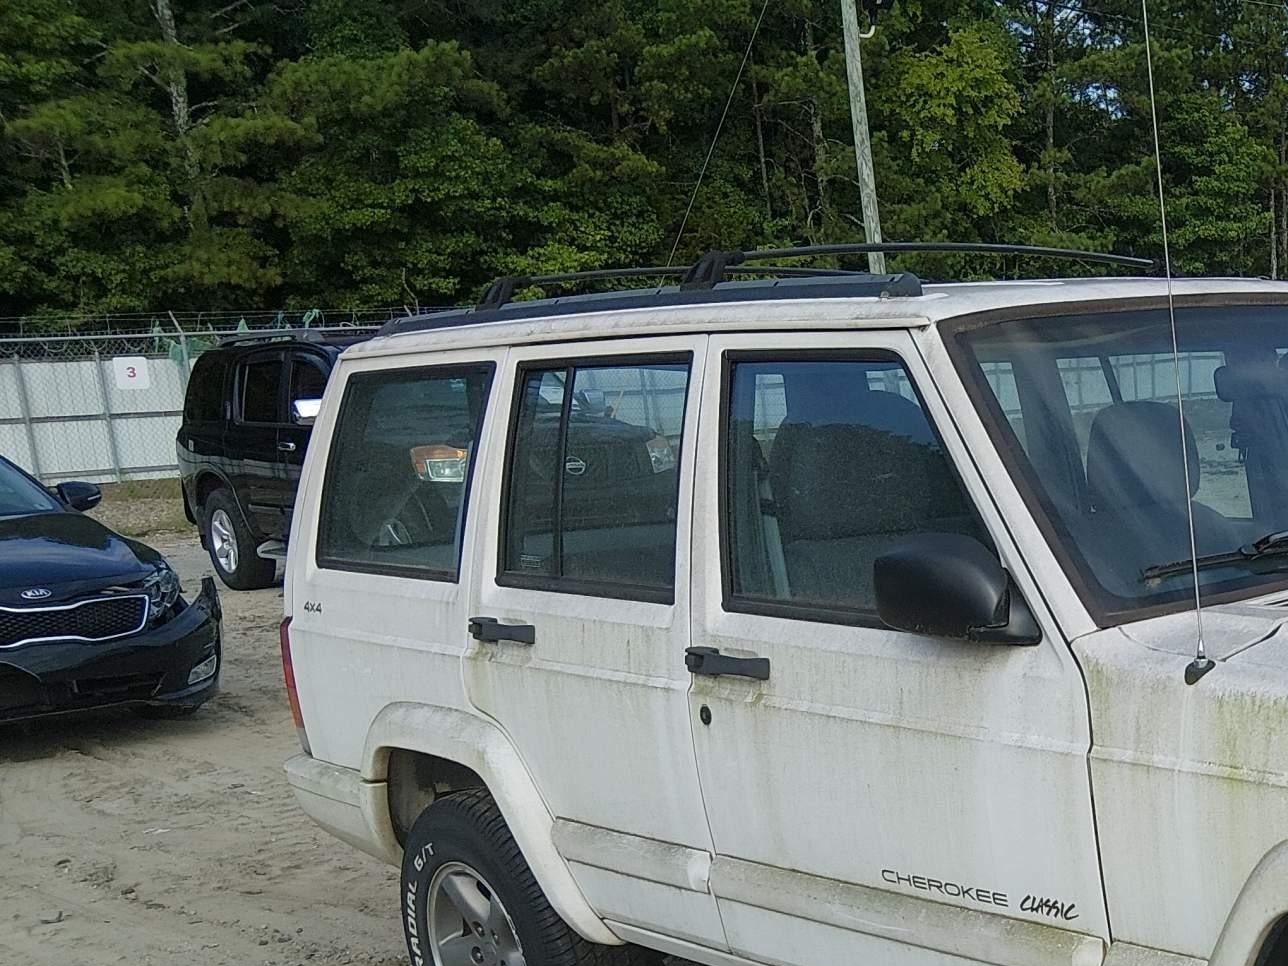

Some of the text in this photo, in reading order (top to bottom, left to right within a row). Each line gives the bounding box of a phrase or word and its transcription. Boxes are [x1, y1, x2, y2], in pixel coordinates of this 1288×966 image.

[126, 366, 137, 378] 3
[414, 842, 435, 872] G/T
[882, 869, 1079, 920] CHEROKEE CLASSIC
